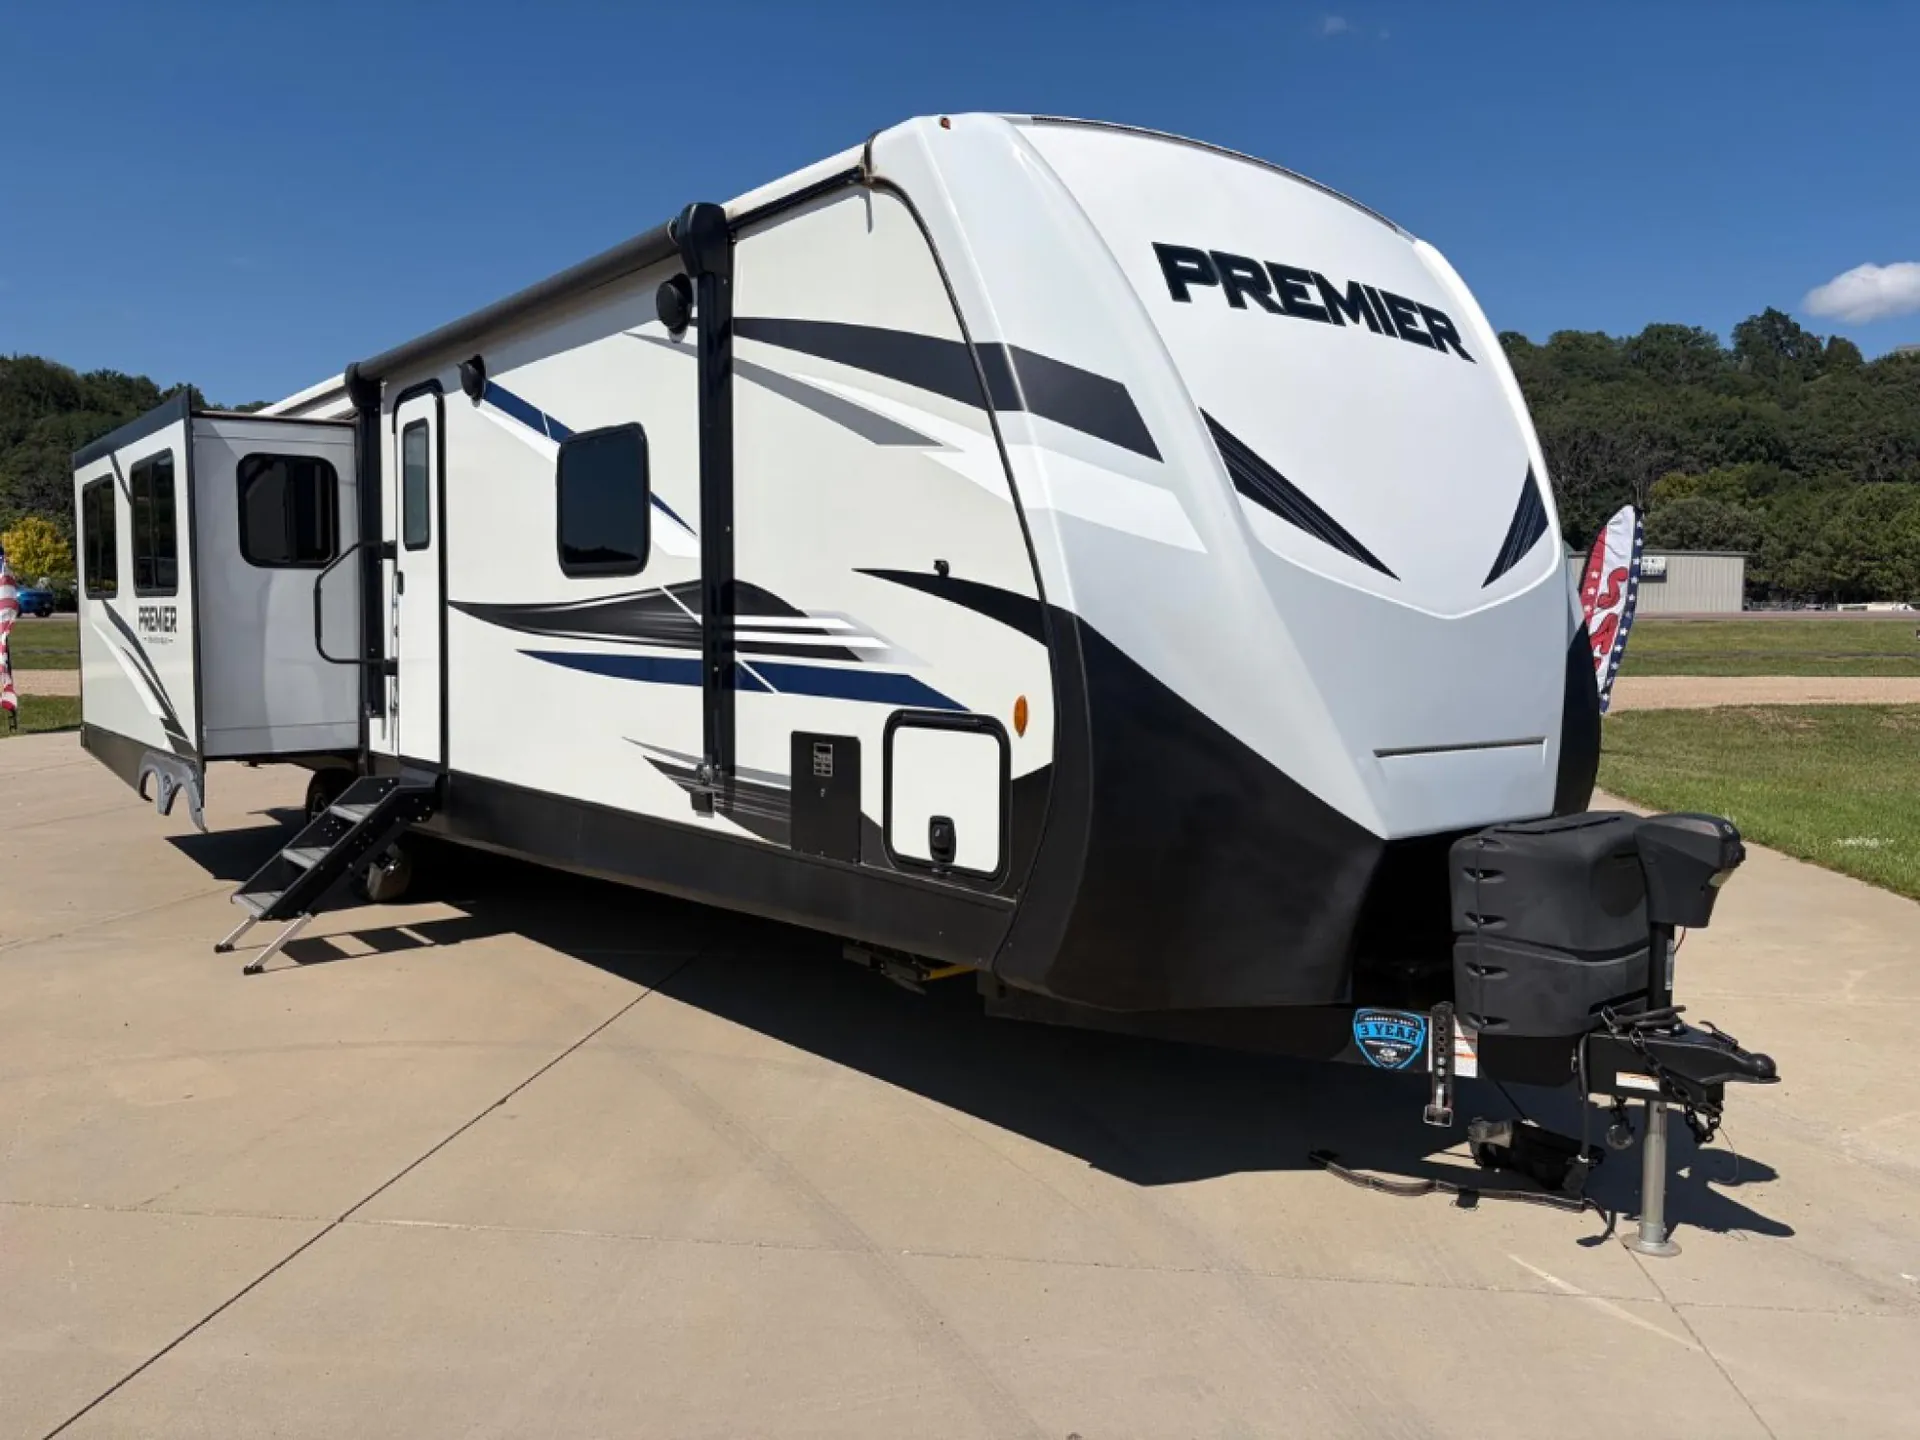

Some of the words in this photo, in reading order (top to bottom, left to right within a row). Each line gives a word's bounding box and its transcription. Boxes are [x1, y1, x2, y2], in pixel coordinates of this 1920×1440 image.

[1151, 241, 1477, 364] PREMIER
[139, 606, 177, 632] PREMIER
[1360, 1025, 1370, 1036] 3
[1374, 1023, 1417, 1041] YEAR
